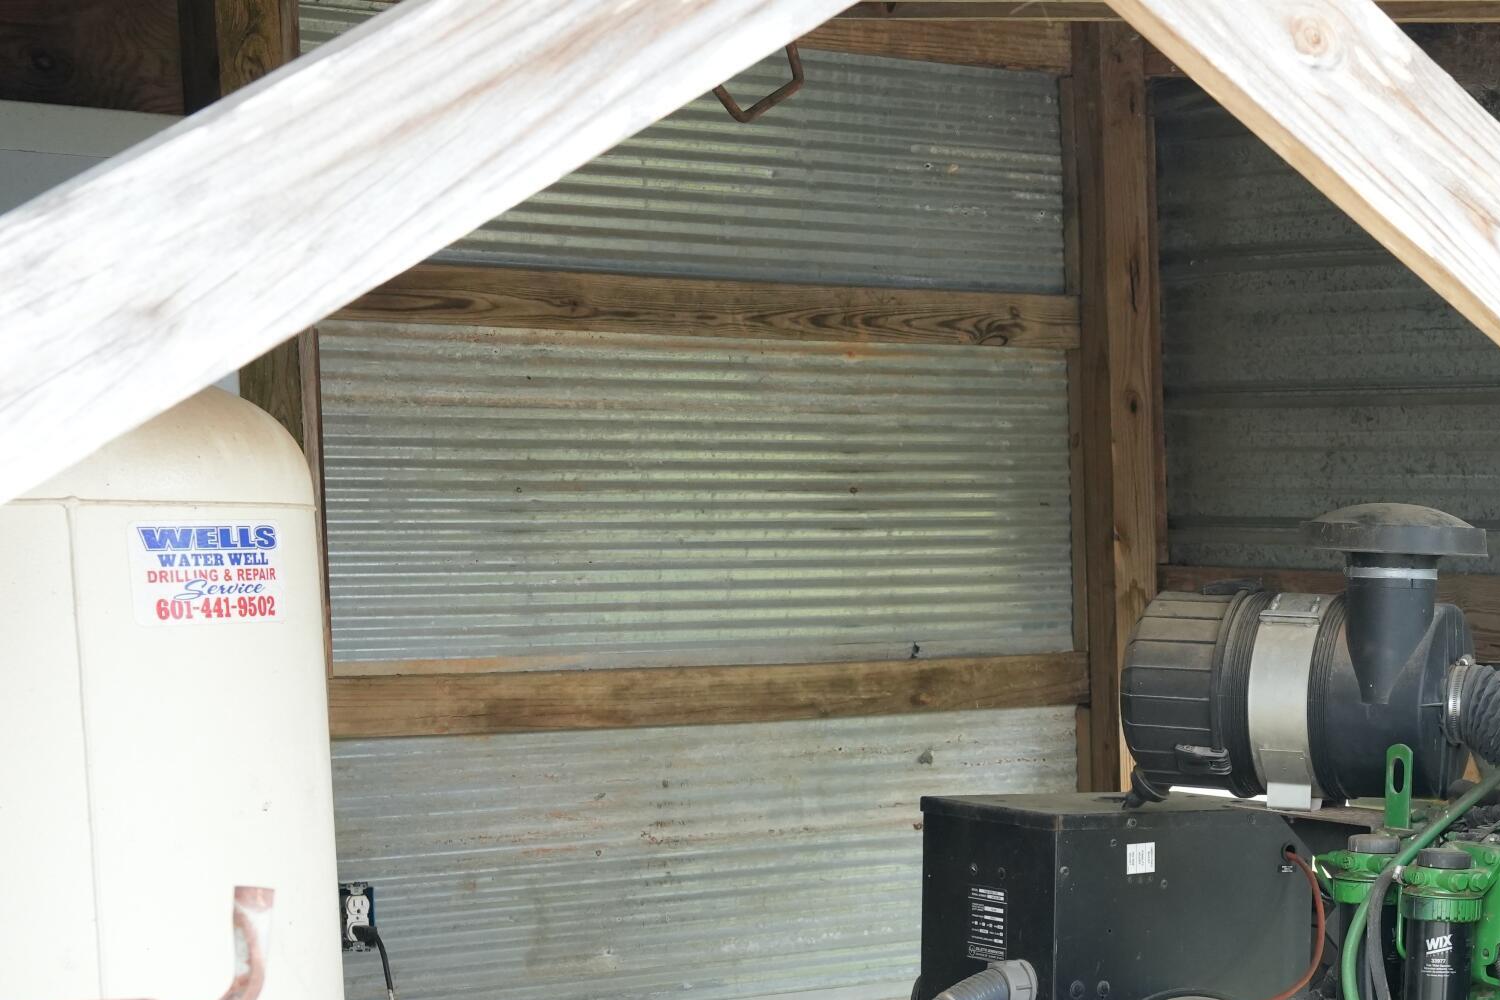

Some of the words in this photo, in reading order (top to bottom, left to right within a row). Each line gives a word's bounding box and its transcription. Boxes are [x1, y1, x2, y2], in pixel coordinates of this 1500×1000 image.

[137, 525, 277, 551] WELLS
[157, 553, 225, 567] WATER
[227, 552, 269, 566] WELL
[147, 569, 218, 583] DRILLING
[224, 568, 232, 581] &
[237, 567, 276, 581] REPAIR
[174, 579, 265, 600] Service
[156, 596, 276, 620] 601-441-9502
[1425, 934, 1453, 950] WIX
